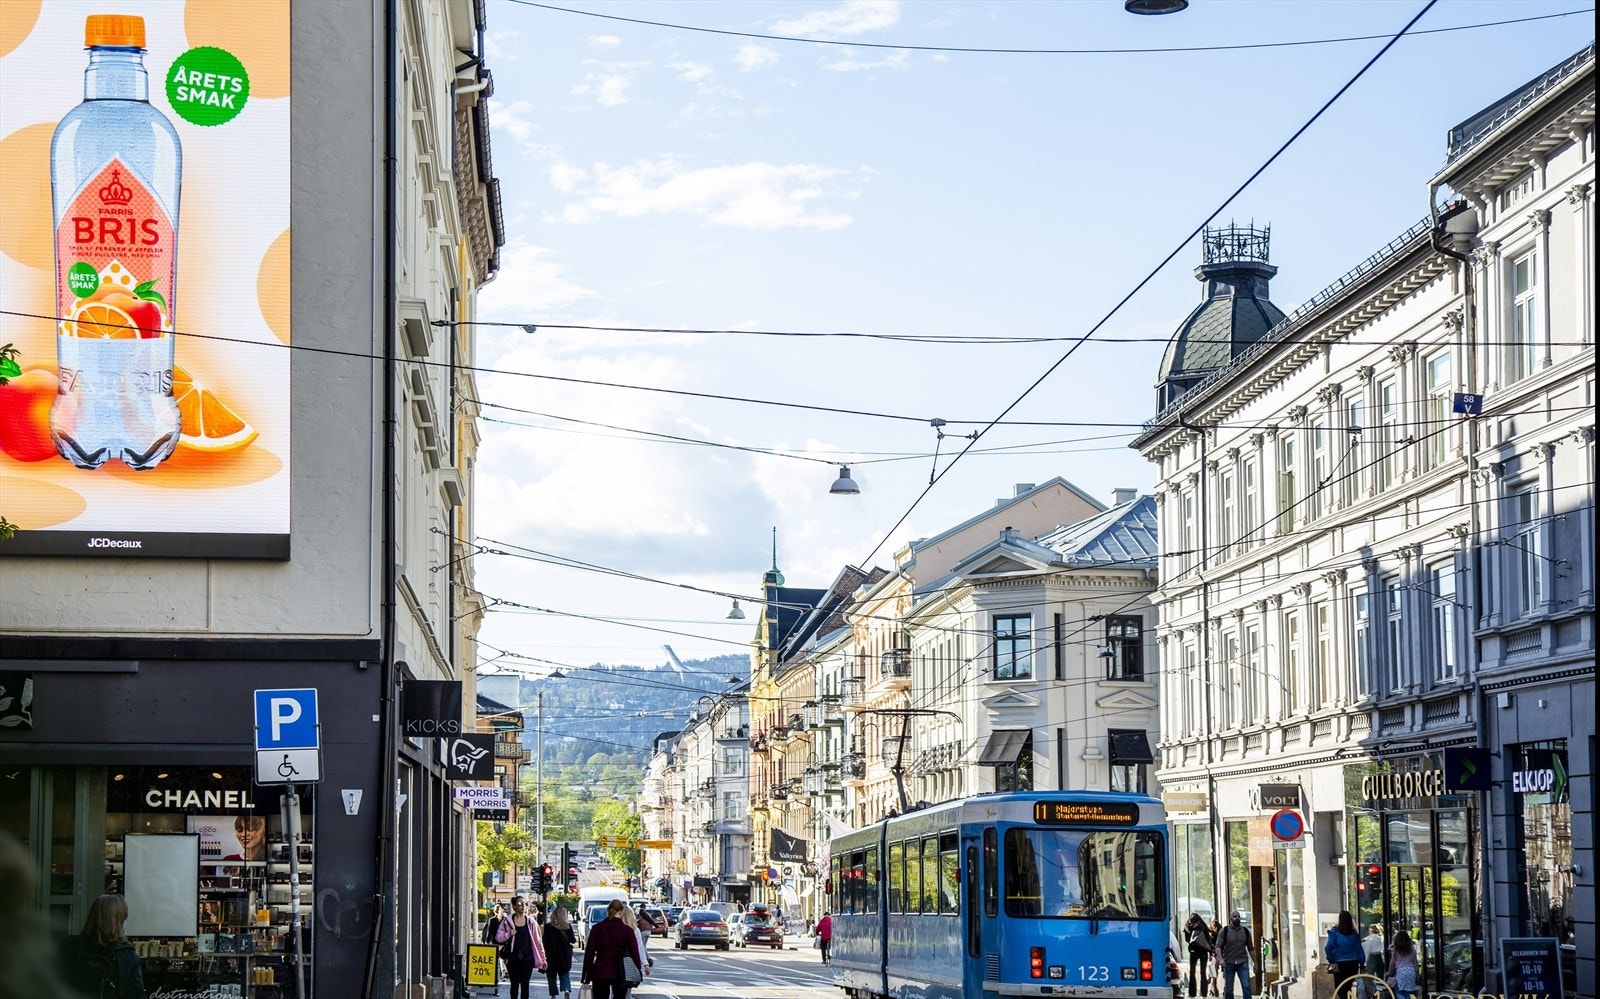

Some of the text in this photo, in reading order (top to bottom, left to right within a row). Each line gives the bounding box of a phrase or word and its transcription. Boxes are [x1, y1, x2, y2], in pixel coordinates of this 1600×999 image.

[173, 65, 243, 93] ÅRETS
[176, 86, 236, 109] SMAK
[98, 208, 134, 216] FARRIS
[71, 217, 159, 245] BRIS
[69, 272, 96, 282] ÅRETS
[71, 281, 95, 289] SMAK
[1463, 395, 1475, 403] 58
[1464, 404, 1472, 413] V
[87, 538, 142, 548] JCDecaux
[270, 697, 302, 741] P
[406, 719, 458, 733] KICKS
[1362, 769, 1451, 800] GULLBORGE
[460, 789, 499, 797] MORRIS
[145, 789, 255, 808] CHANEL
[1183, 798, 1204, 806] BOK
[1263, 796, 1298, 805] VOLT
[779, 852, 804, 860] Valkyrien
[472, 955, 494, 964] SALE
[474, 967, 491, 976] 70%
[1078, 965, 1109, 981] 123
[1521, 964, 1542, 974] 10-19
[1523, 981, 1544, 991] 10-18
